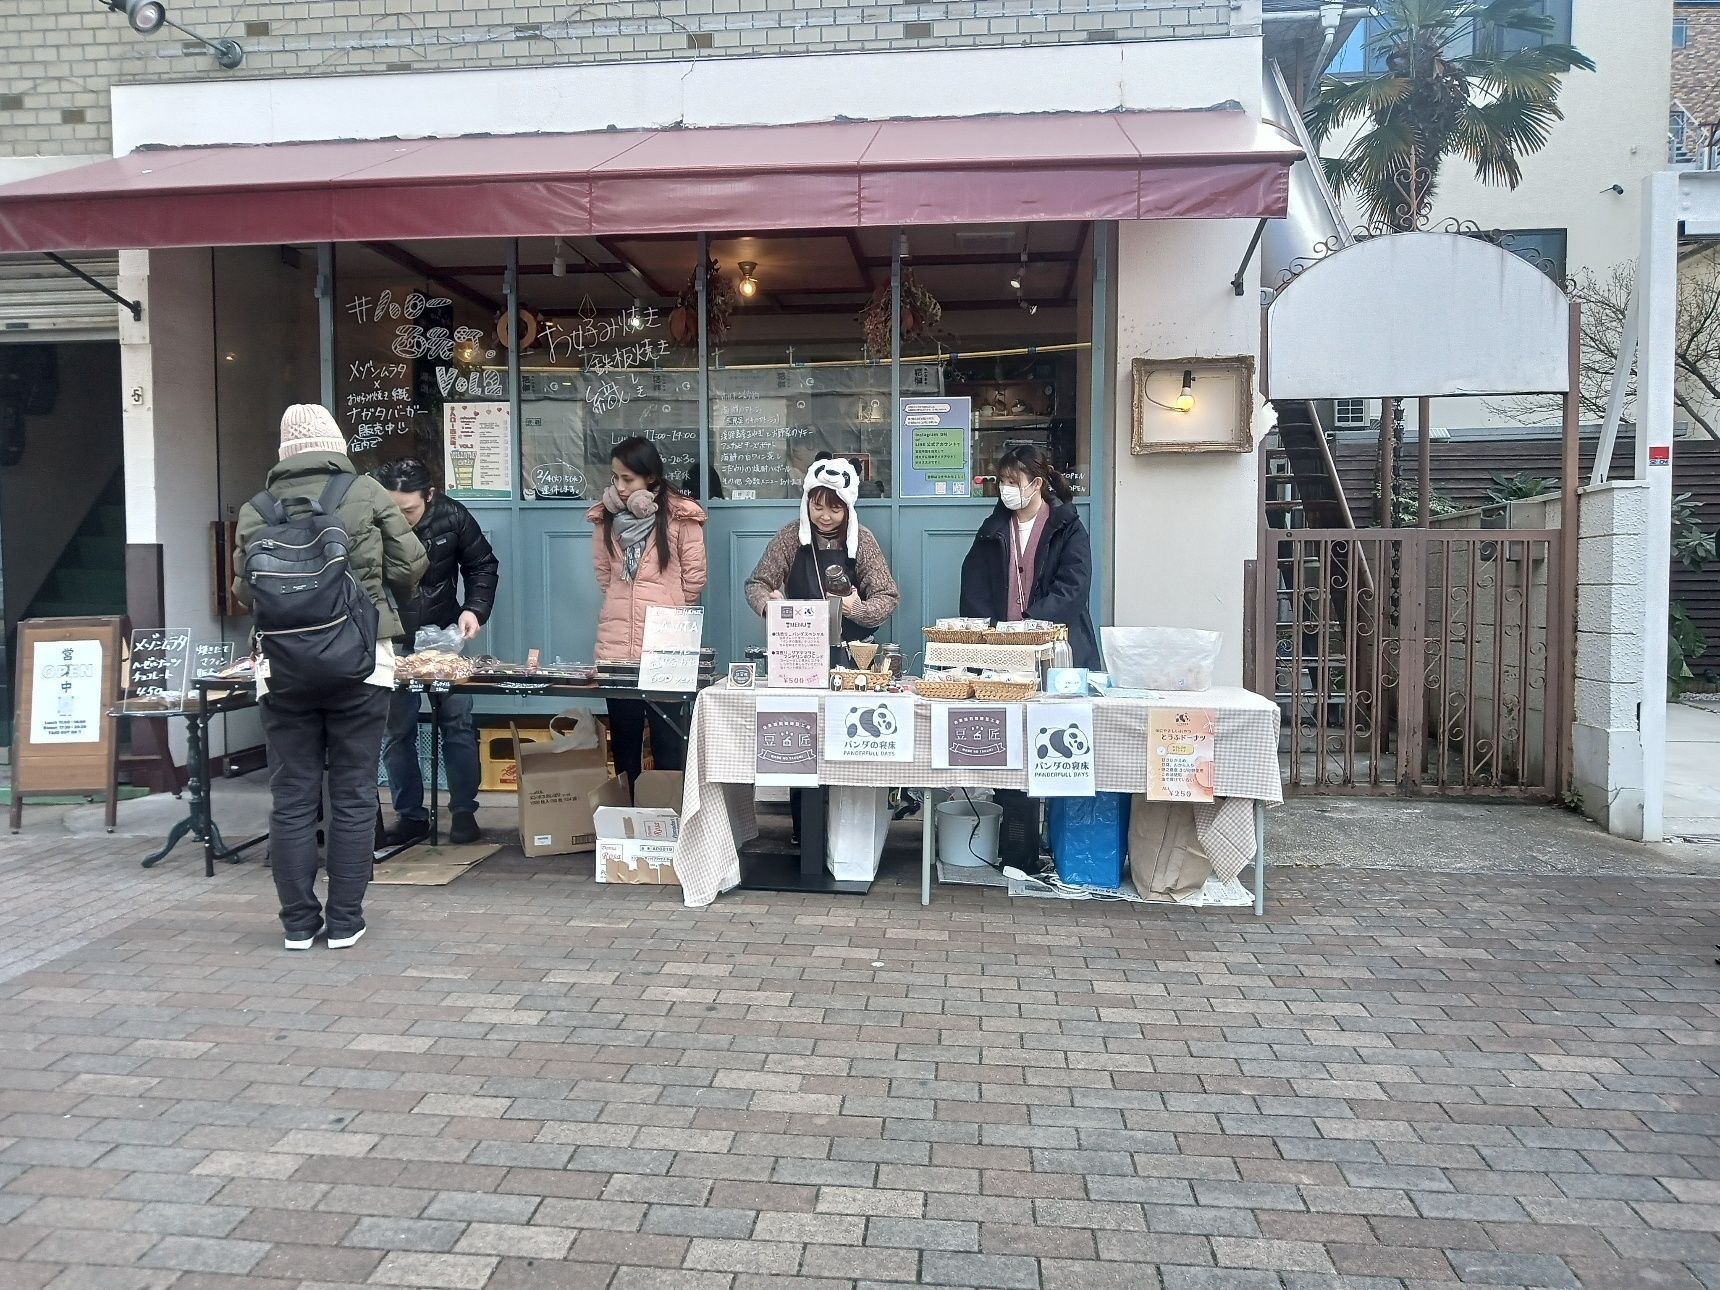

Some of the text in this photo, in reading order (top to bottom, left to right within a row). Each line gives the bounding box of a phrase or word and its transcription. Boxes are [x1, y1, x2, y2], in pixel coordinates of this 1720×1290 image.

[349, 360, 407, 381] メゾンムラタ
[131, 389, 142, 403] 5
[346, 405, 429, 424] ナガタバーガー
[358, 422, 395, 437] 販売中
[133, 632, 188, 652] メゾンムラタ
[195, 644, 230, 656] 焼きたて
[199, 657, 228, 667] マフィン
[131, 669, 174, 682] チョコレート
[1161, 734, 1206, 742] とうふドーナツ
[844, 741, 897, 750] パンダの寝床
[1034, 761, 1090, 771] パンダの寝床
